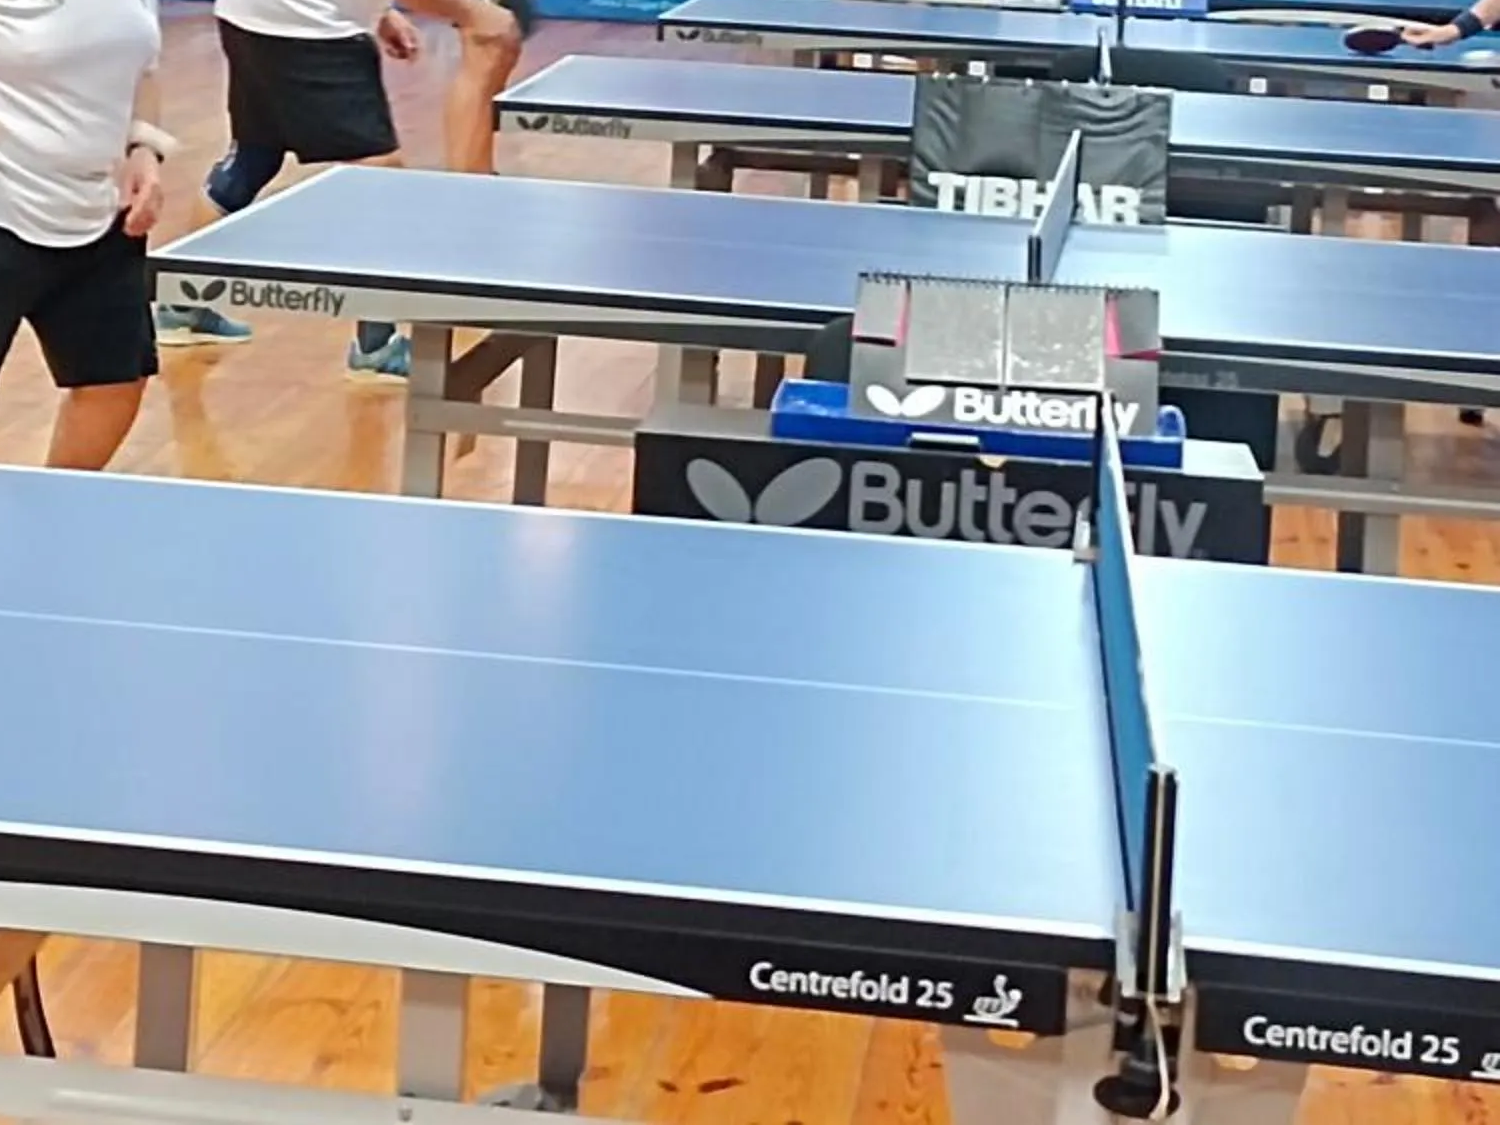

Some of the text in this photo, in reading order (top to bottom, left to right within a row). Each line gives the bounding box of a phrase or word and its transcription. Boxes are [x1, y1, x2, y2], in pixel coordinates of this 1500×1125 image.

[229, 279, 345, 318] Butterfly
[953, 386, 1140, 436] Butterfy
[849, 460, 1208, 559] Buttely
[749, 961, 954, 1010] Centrefold 25
[1243, 1015, 1461, 1066] Centrefold 25
